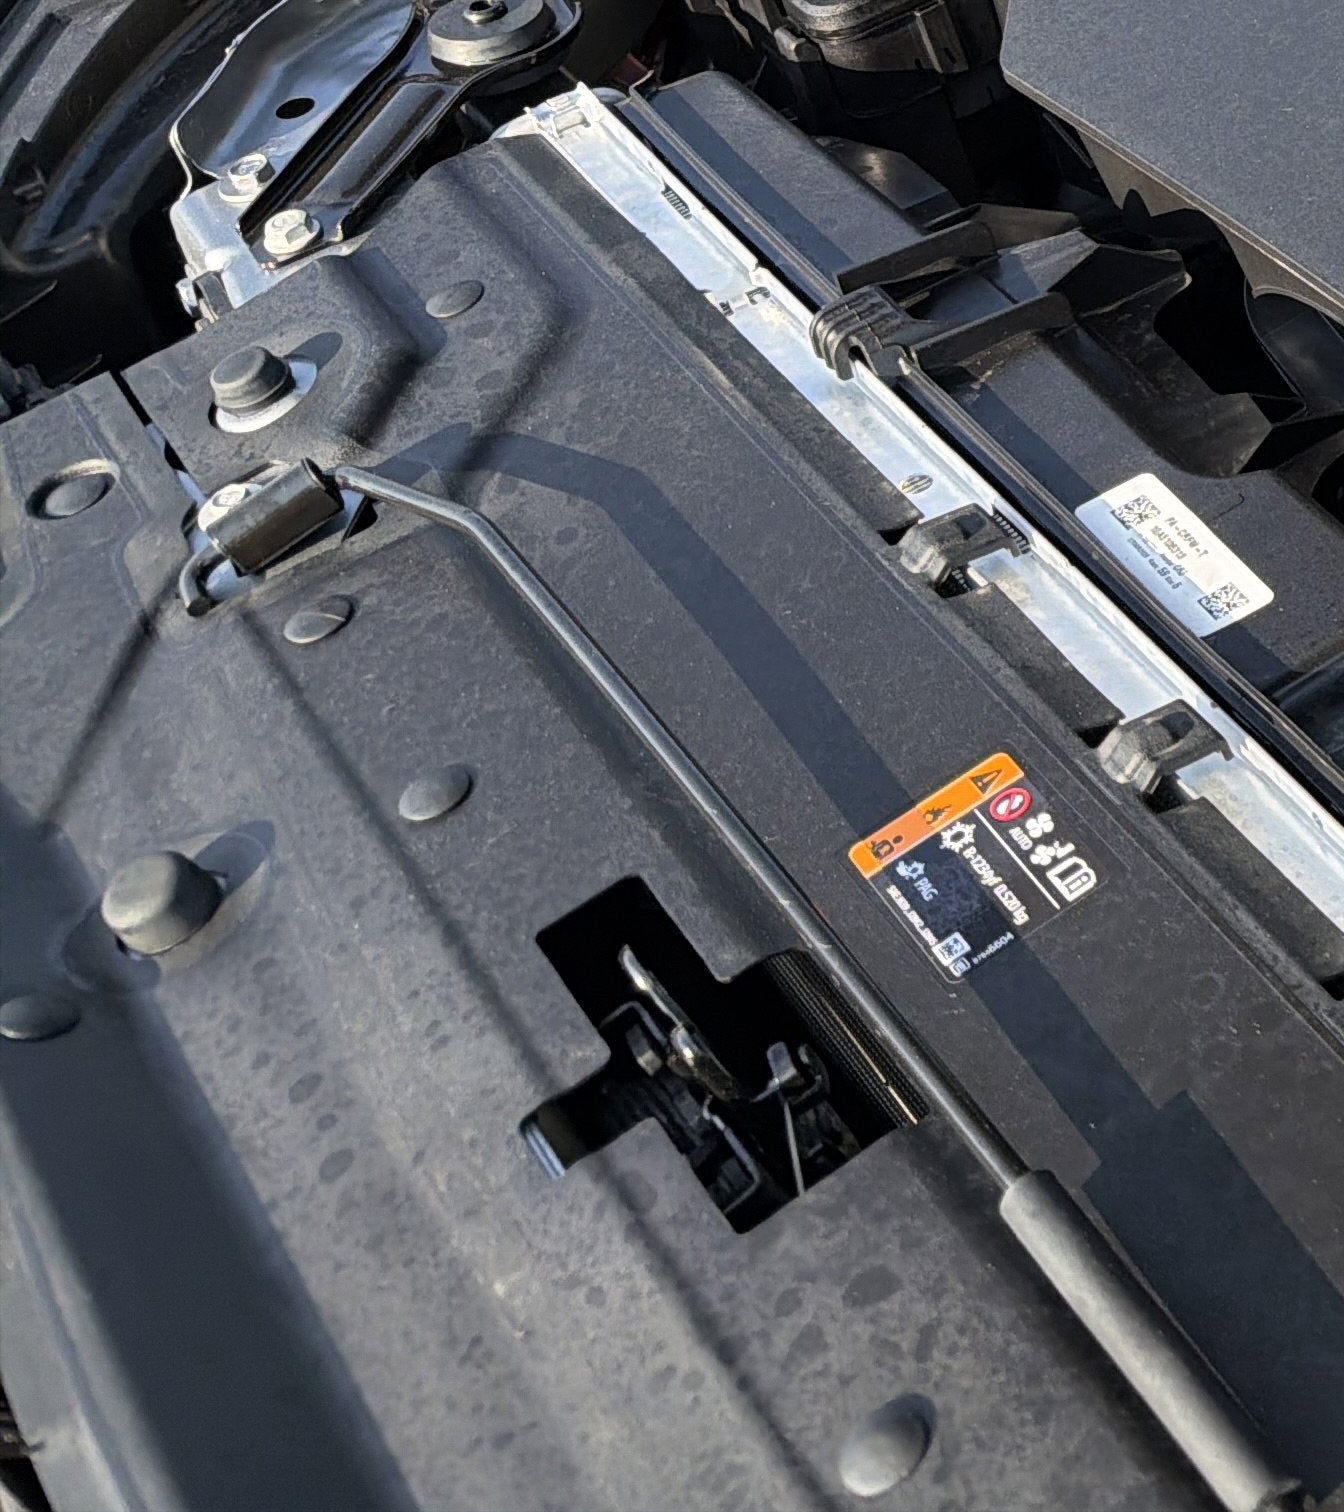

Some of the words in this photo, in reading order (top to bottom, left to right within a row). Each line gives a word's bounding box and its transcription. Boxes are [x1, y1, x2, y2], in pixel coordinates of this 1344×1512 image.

[1008, 826, 1033, 851] AUTO
[914, 876, 938, 902] PAG
[962, 845, 1004, 888] R-1234yf
[994, 883, 1022, 913] 0.520
